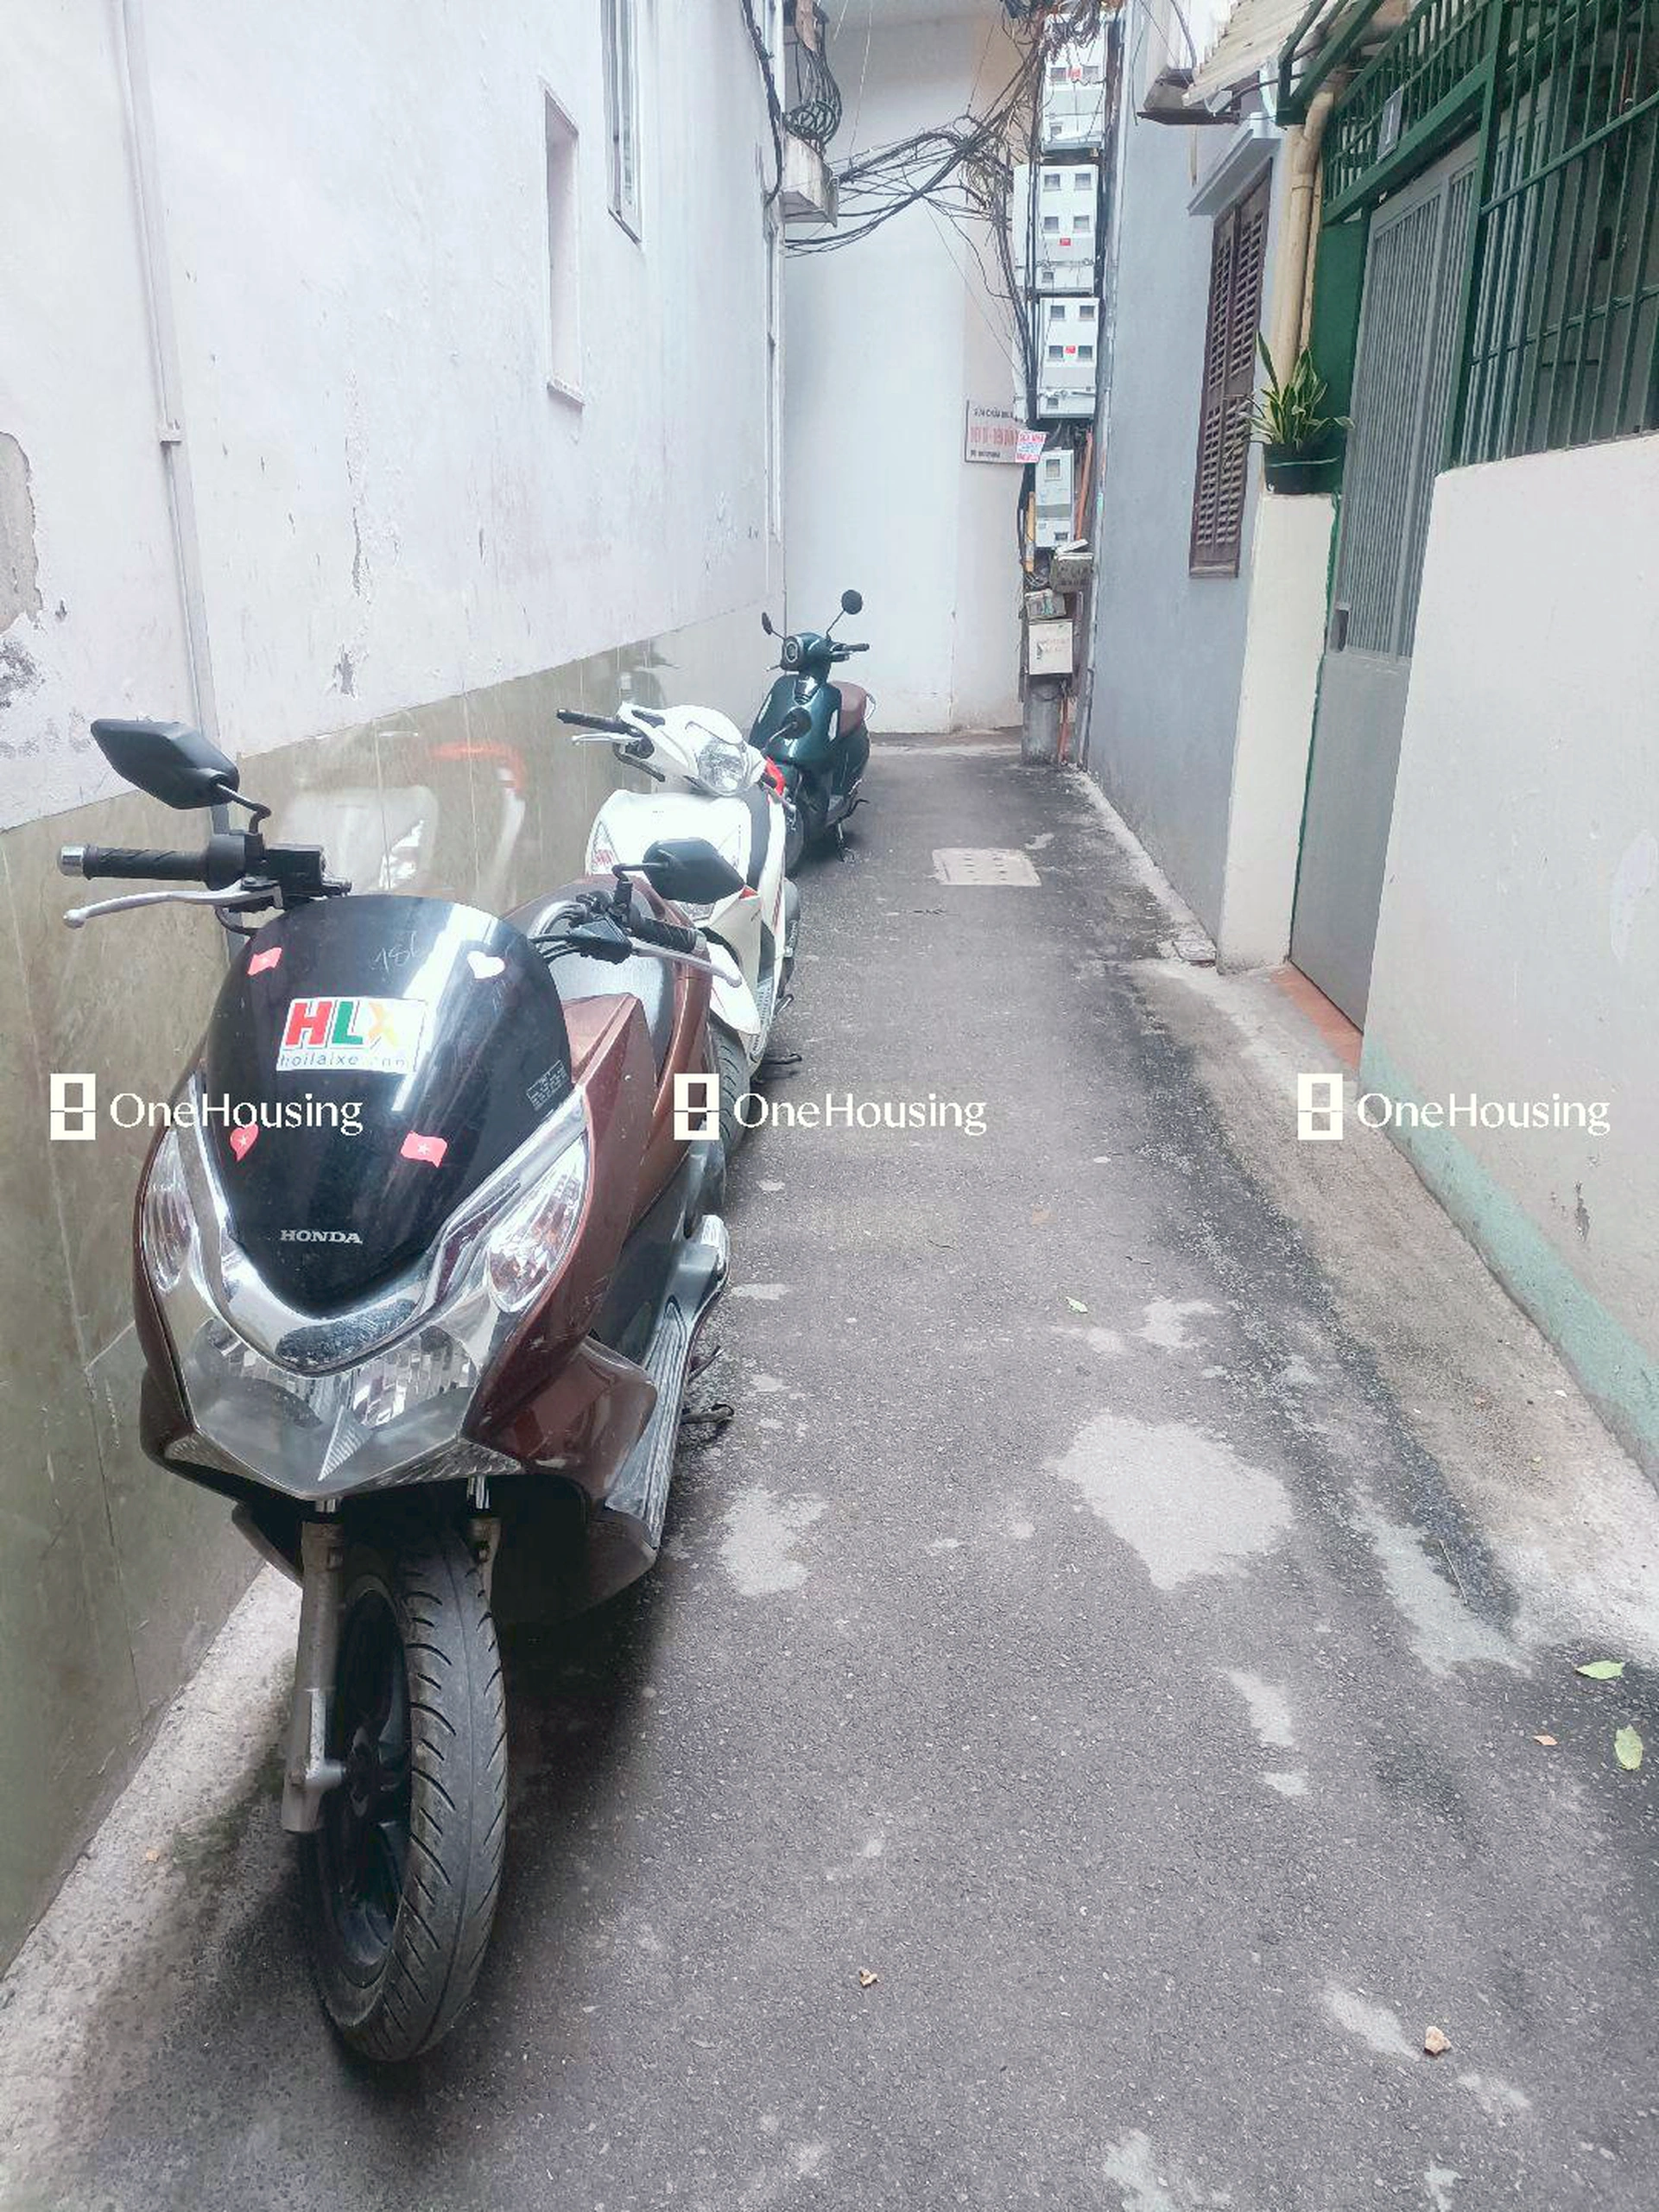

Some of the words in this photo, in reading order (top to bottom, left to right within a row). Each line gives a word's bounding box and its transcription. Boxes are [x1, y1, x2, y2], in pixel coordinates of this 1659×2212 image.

[285, 1001, 398, 1047] HLX
[280, 1052, 406, 1068] hoilaixeom
[280, 1229, 364, 1245] HONDA
